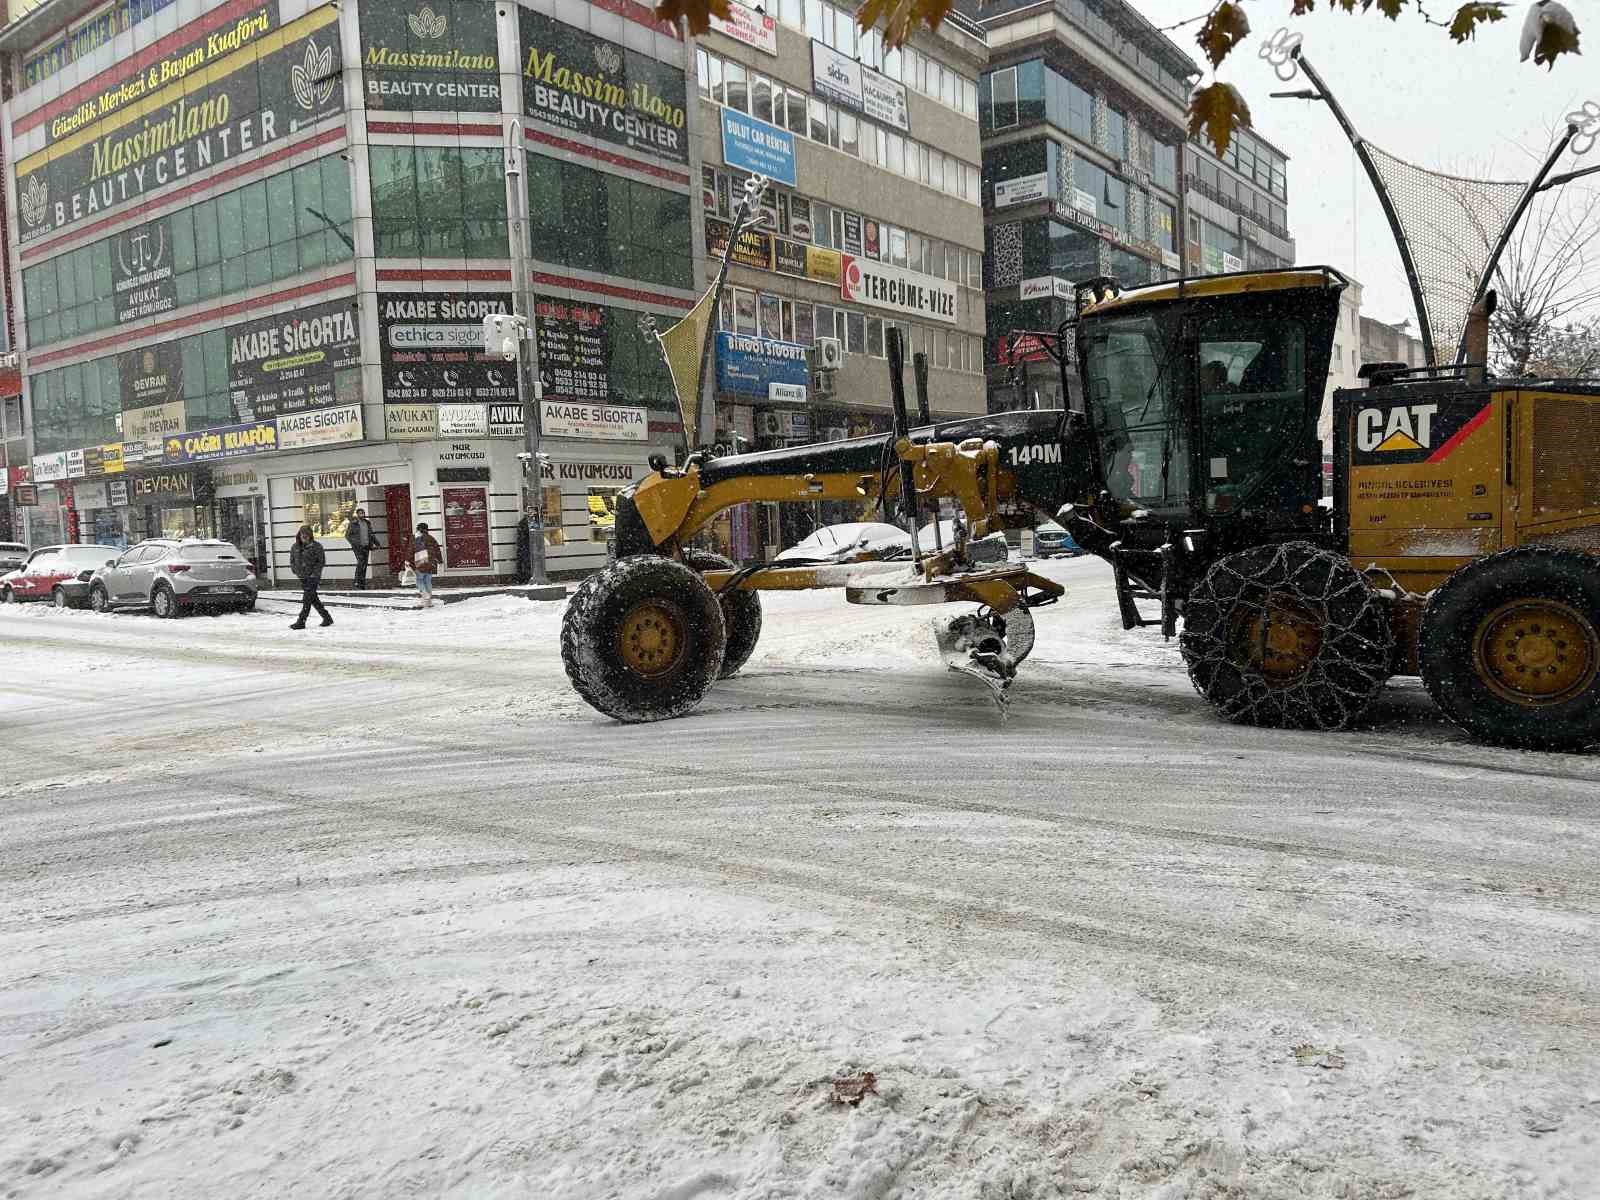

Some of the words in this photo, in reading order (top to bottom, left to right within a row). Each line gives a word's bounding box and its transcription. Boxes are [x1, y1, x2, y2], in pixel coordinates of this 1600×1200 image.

[365, 47, 495, 69] Massimilano
[52, 105, 96, 138] Güzellik
[98, 74, 146, 115] Merkezi
[148, 67, 158, 88] &
[160, 48, 204, 82] Bayan
[207, 9, 269, 58] Kuaförü
[368, 80, 432, 96] BEAUTY
[437, 82, 500, 98] CENTER
[535, 85, 607, 131] BEAUTY
[612, 111, 678, 150] CENTER
[89, 93, 229, 181] Massimilano
[727, 119, 750, 141] BULUT
[751, 129, 765, 145] CAR
[766, 133, 792, 156] RENTAL
[1056, 203, 1076, 220] AHMET
[1077, 211, 1100, 232] DURSUN
[129, 286, 159, 305] AVUKAT
[863, 273, 954, 316] TERCÜME-VİZE
[386, 301, 437, 319] AKABE
[440, 300, 508, 319] SİGORTA
[231, 328, 280, 364] AKABE
[283, 311, 355, 353] SİGORTA
[394, 328, 443, 342] ethica
[134, 375, 167, 391] DEVRAN
[149, 417, 180, 434] DEVRAN
[280, 417, 312, 434] AKABE
[314, 409, 358, 428] SİGORTA
[388, 409, 435, 422] AVUKAT
[546, 405, 589, 421] AKABE
[592, 407, 643, 425] SİGORTA
[1357, 404, 1438, 452] CAT
[184, 431, 222, 459] ÇAĞRI
[224, 425, 276, 449] KUAFÖR
[452, 443, 471, 451] NUR
[439, 452, 486, 461] KUYUMCUSU
[1008, 443, 1062, 466] 140M
[294, 475, 315, 491] NUR
[318, 470, 379, 490] KUYUMCUSU
[560, 463, 633, 480] KUYUMCUSU
[136, 474, 188, 496] DEVRAN
